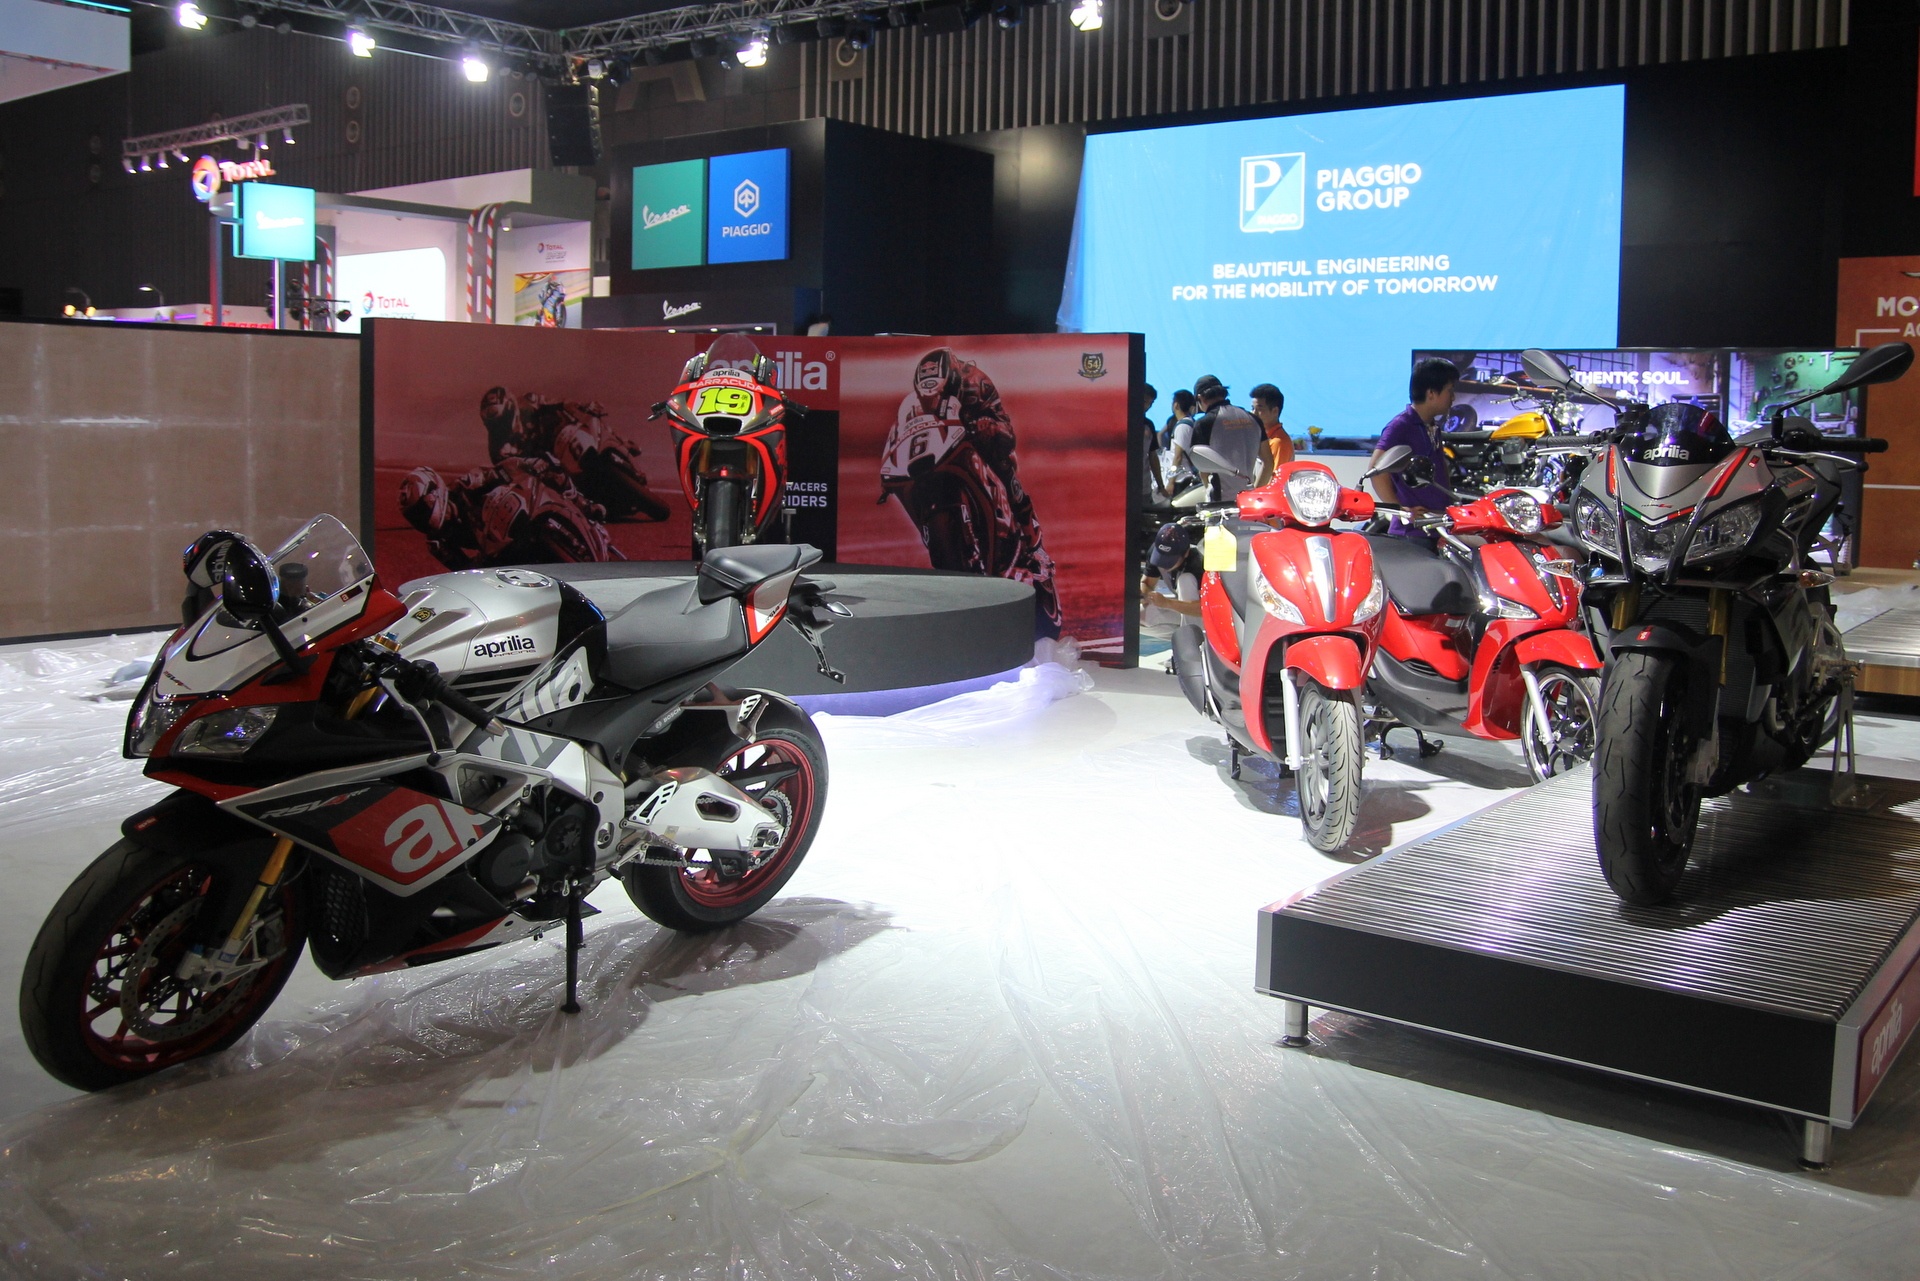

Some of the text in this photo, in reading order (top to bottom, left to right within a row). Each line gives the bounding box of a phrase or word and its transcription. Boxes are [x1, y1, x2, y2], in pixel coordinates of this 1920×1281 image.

[1316, 162, 1421, 190] PIAGGIO
[1316, 187, 1410, 212] GROUP
[643, 205, 691, 230] Vespa
[722, 223, 771, 237] PIAGGIO
[1212, 254, 1450, 280] BEAUTIFUL ENGINEERING
[1172, 275, 1498, 301] FOR THE MOBILITY OF TOMORROW
[377, 296, 409, 308] TOTAL
[663, 300, 701, 320] Vespa
[712, 369, 740, 378] aprilia
[1641, 371, 1690, 385] SOUL.
[688, 378, 764, 393] BARRACUDA
[696, 387, 753, 416] 19
[909, 430, 930, 460] 6
[1643, 445, 1690, 461] aprilia
[474, 635, 535, 658] aprilia
[663, 706, 682, 723] BOSCH
[1871, 998, 1903, 1076] aprilia
